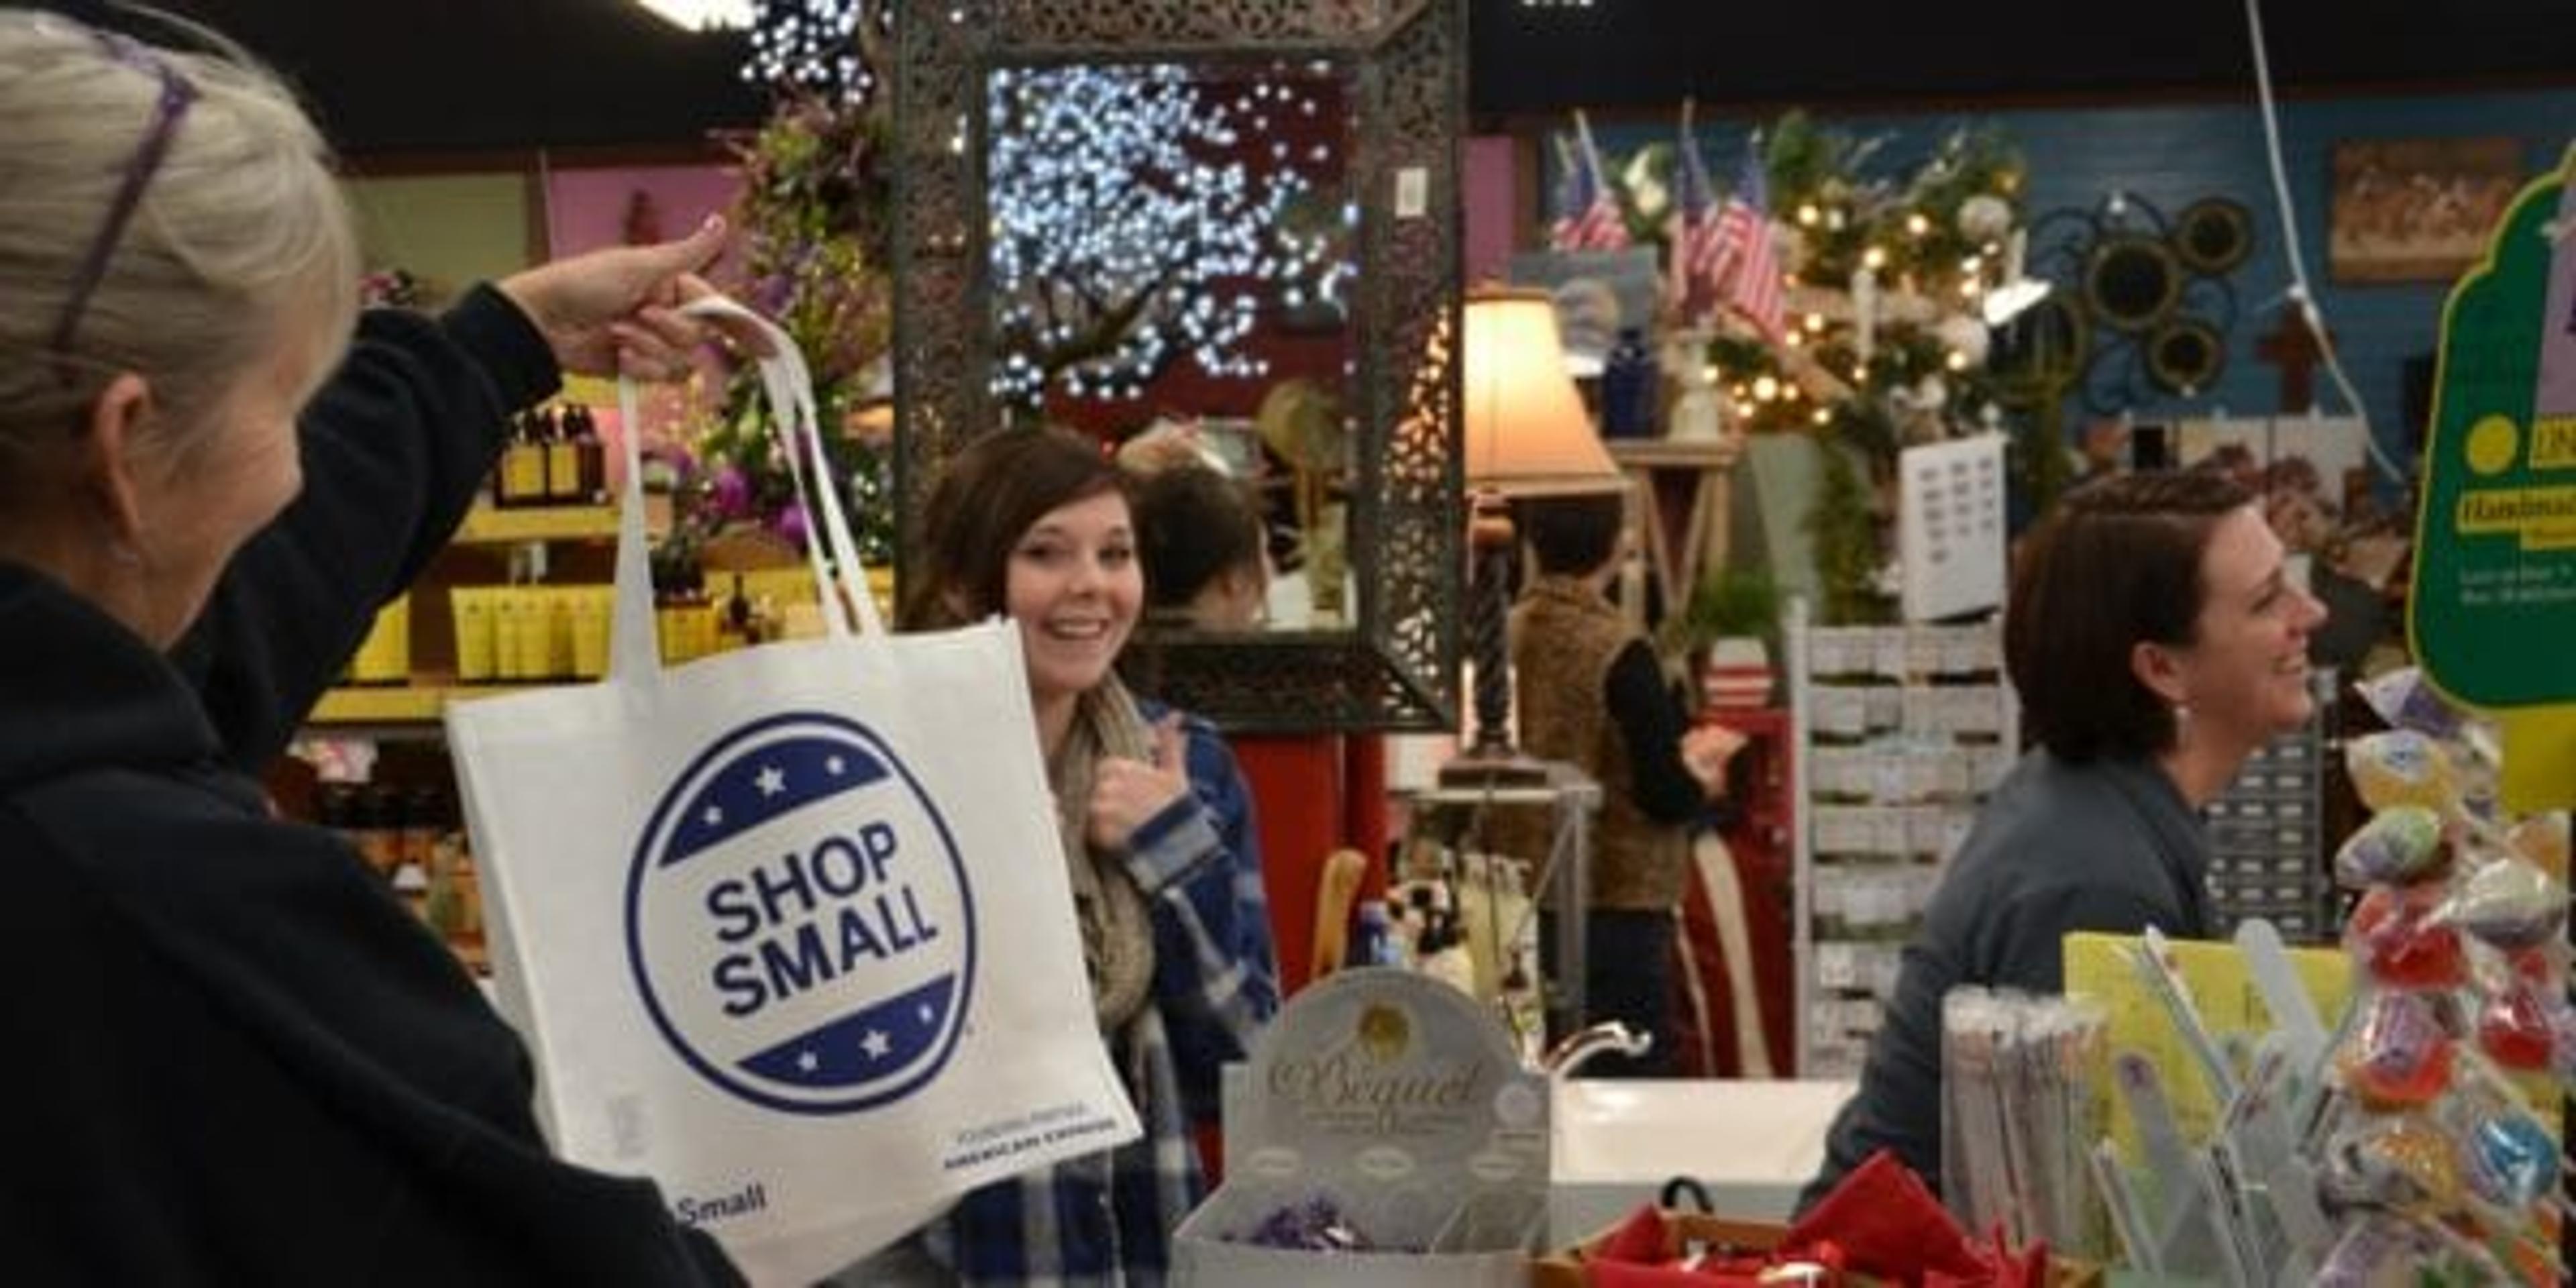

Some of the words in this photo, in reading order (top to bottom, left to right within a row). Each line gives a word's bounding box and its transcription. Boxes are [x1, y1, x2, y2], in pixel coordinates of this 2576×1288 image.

[706, 821, 897, 942] SHOP
[712, 884, 938, 1016] SMALL
[677, 1182, 765, 1225] Small
